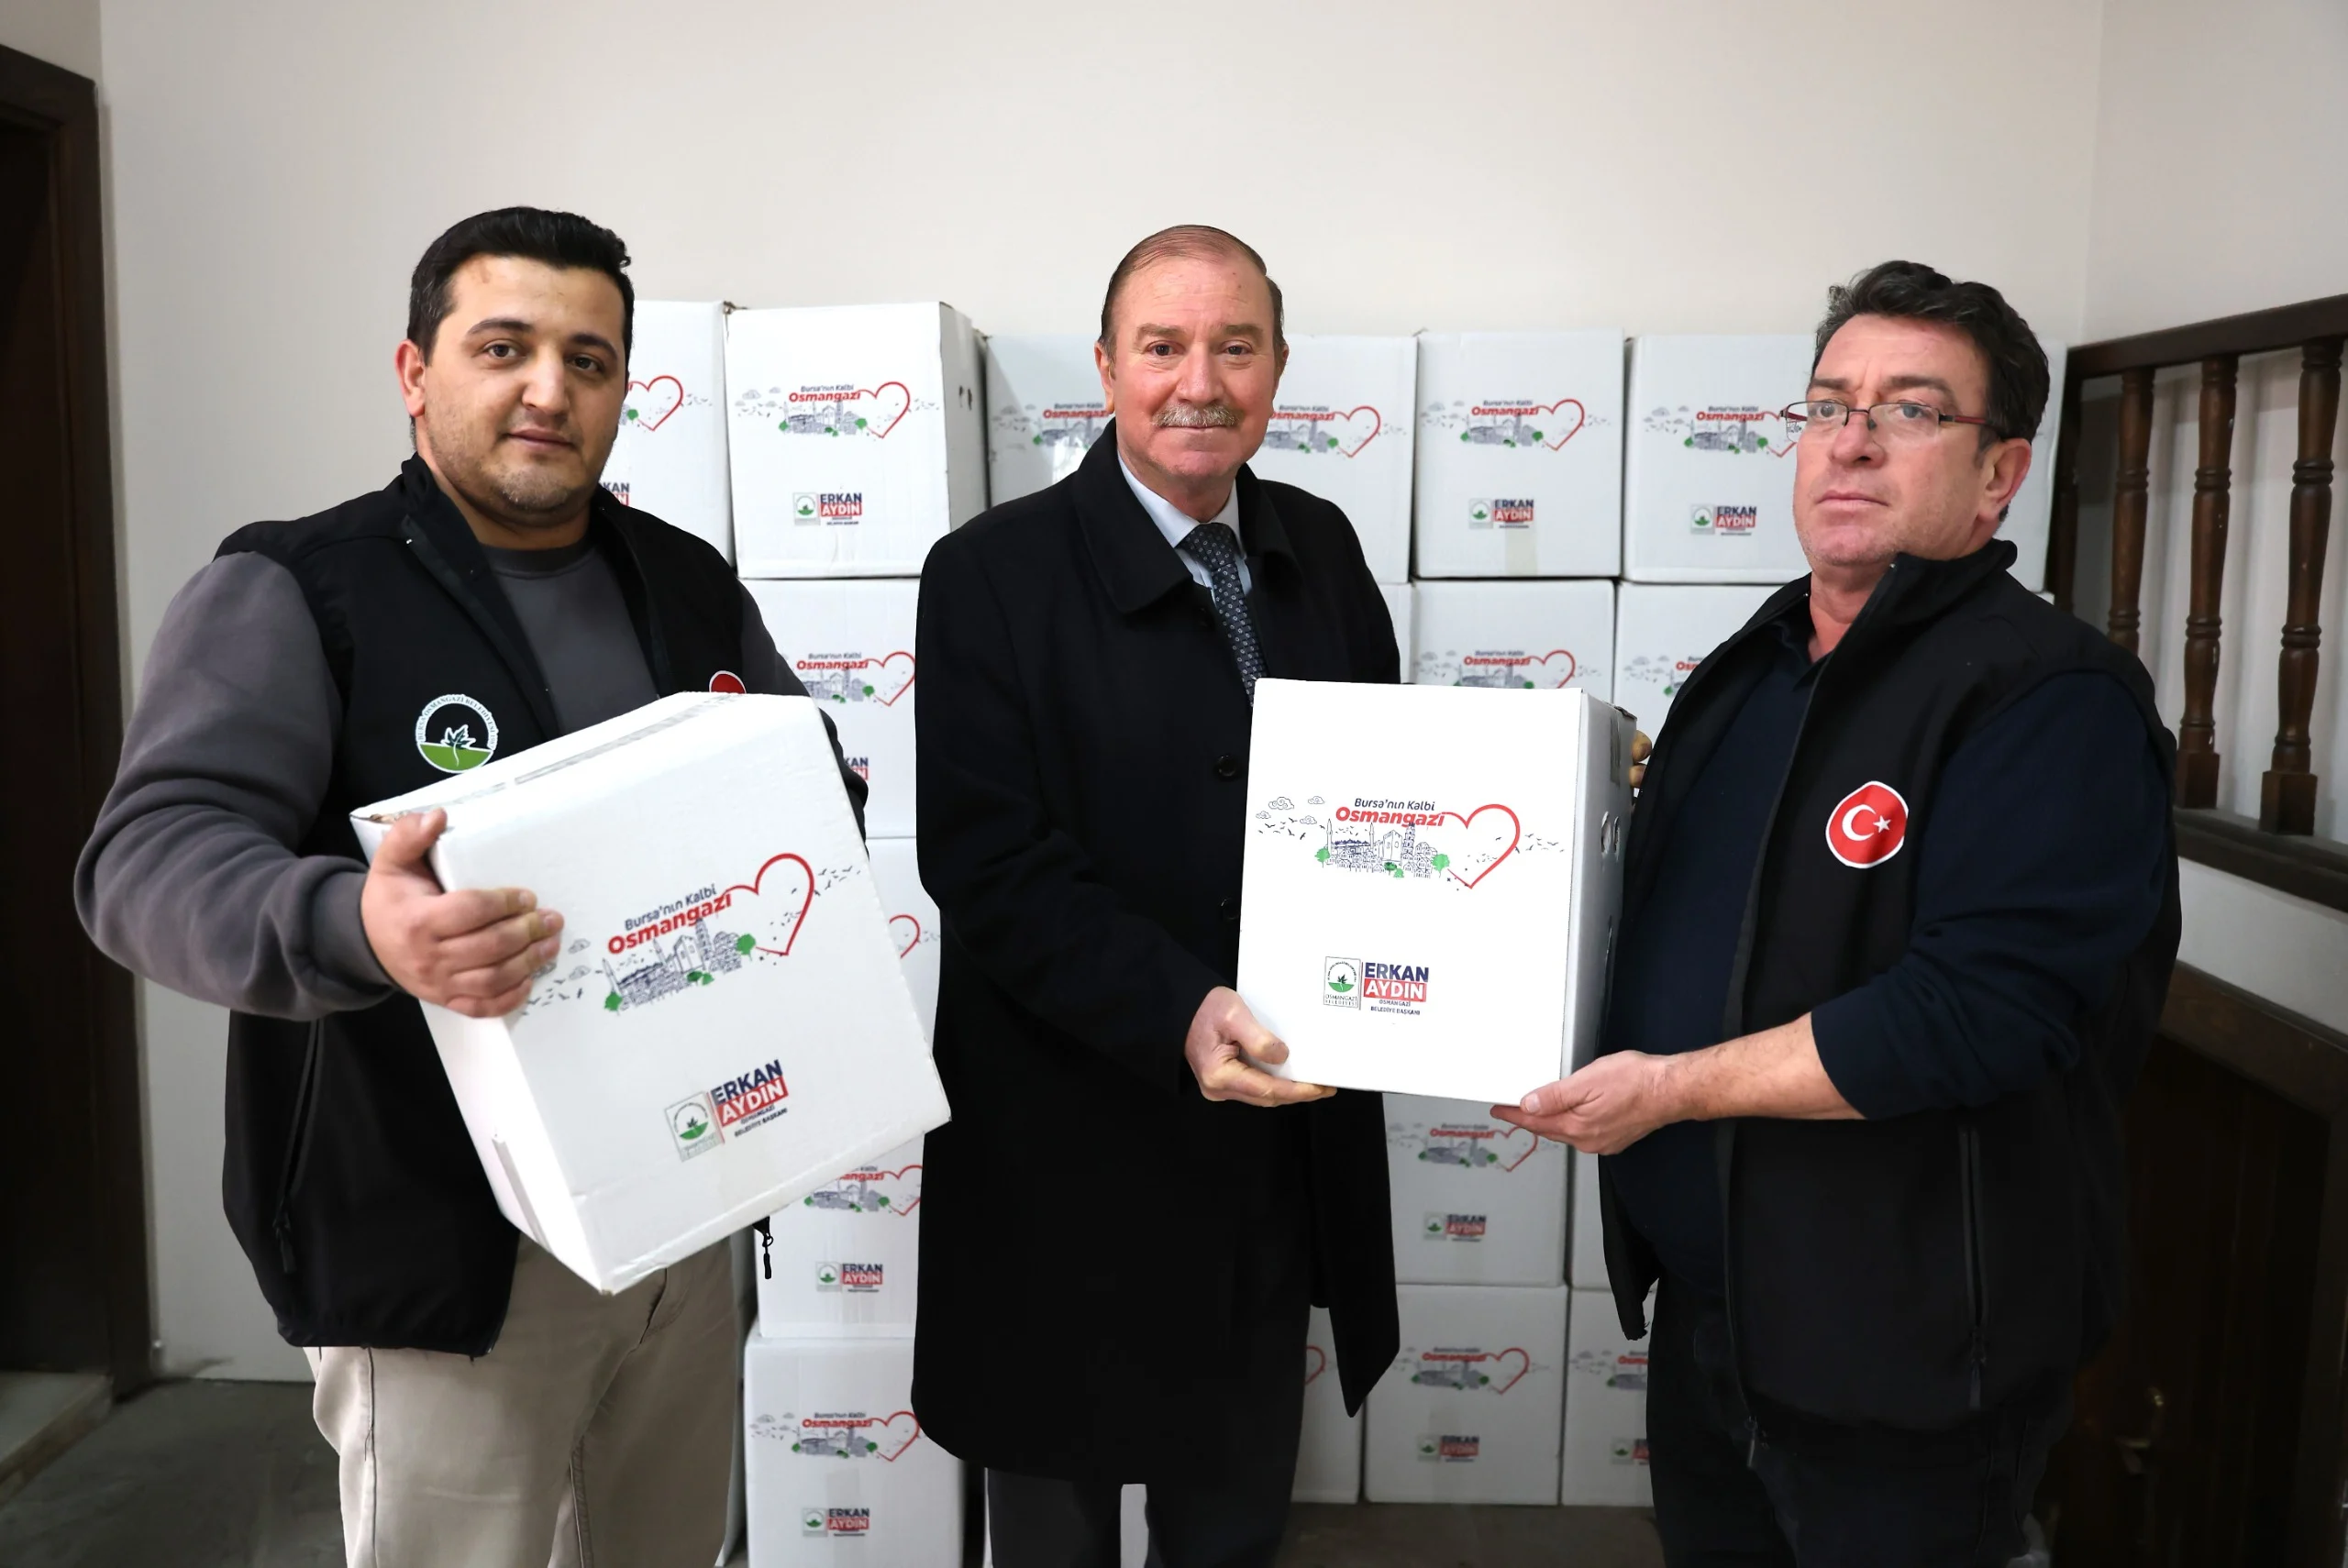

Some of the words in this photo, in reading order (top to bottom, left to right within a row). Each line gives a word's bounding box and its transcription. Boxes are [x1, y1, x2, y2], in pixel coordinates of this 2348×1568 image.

[789, 392, 861, 403] Osmangazi
[1471, 406, 1539, 417] Osmangazi
[1696, 411, 1765, 423] Osmangazi
[603, 481, 630, 493] KAN
[820, 492, 862, 503] ERKAN
[1495, 499, 1534, 508] ERKAN
[822, 503, 860, 516] AYDIN
[1495, 509, 1532, 521] AYDIN
[1717, 506, 1757, 515] ERKAN
[1718, 514, 1755, 526] AYDIN
[796, 660, 869, 671] Osmangazi
[1354, 798, 1404, 810] Bursa'nın
[1407, 801, 1435, 812] Kalbi
[1335, 806, 1445, 828] Osmangazi
[625, 900, 683, 931] Bursa'nın
[685, 883, 717, 906] Kalbi
[608, 893, 732, 955] Osmangazi
[1364, 962, 1430, 983] ERKAN
[1365, 979, 1423, 1000] AYDIN
[710, 1059, 783, 1106] ERKAN
[722, 1078, 784, 1124] AYDIN
[840, 1173, 884, 1183] angazi
[842, 1264, 883, 1273] ERKAN
[844, 1273, 881, 1284] AYDIN
[829, 1507, 869, 1518] ERKAN
